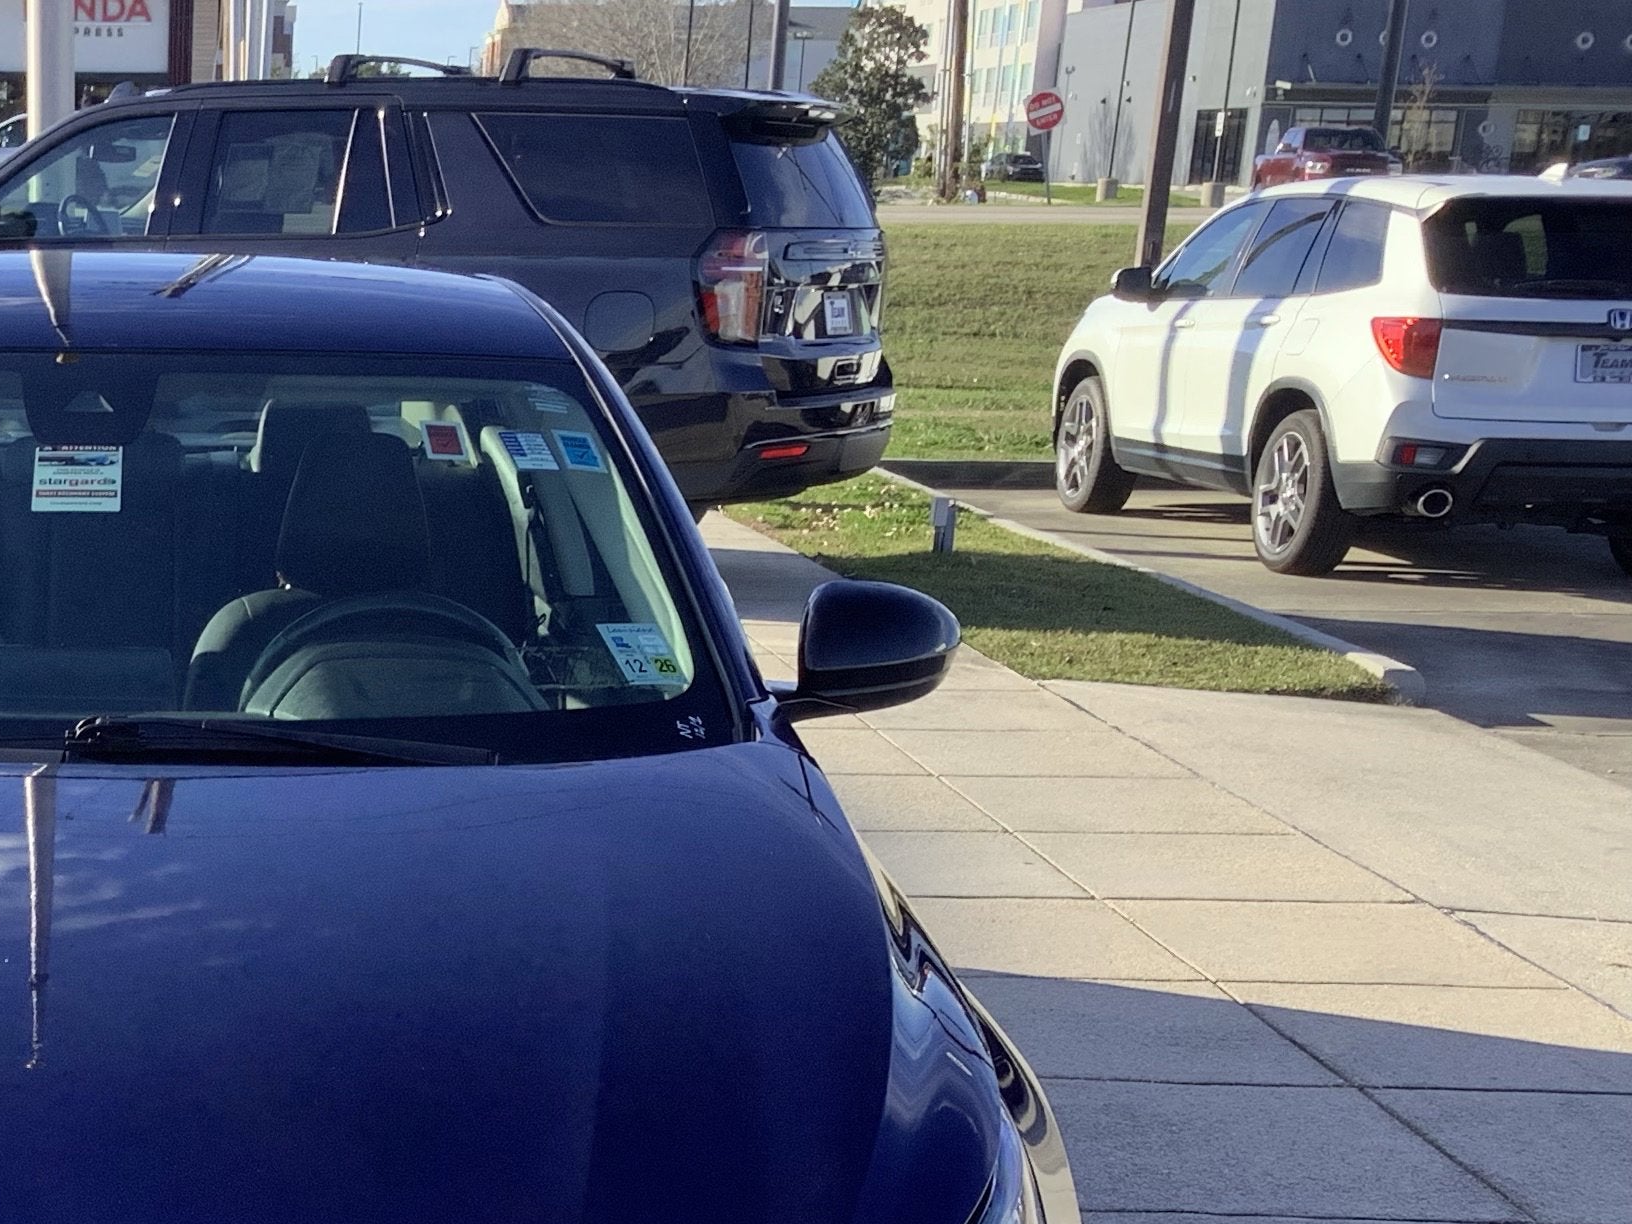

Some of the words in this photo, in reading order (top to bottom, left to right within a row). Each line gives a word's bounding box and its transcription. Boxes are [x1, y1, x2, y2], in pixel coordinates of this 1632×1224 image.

[70, 26, 125, 37] PRESS
[625, 659, 648, 673] 12
[654, 658, 677, 673] 26
